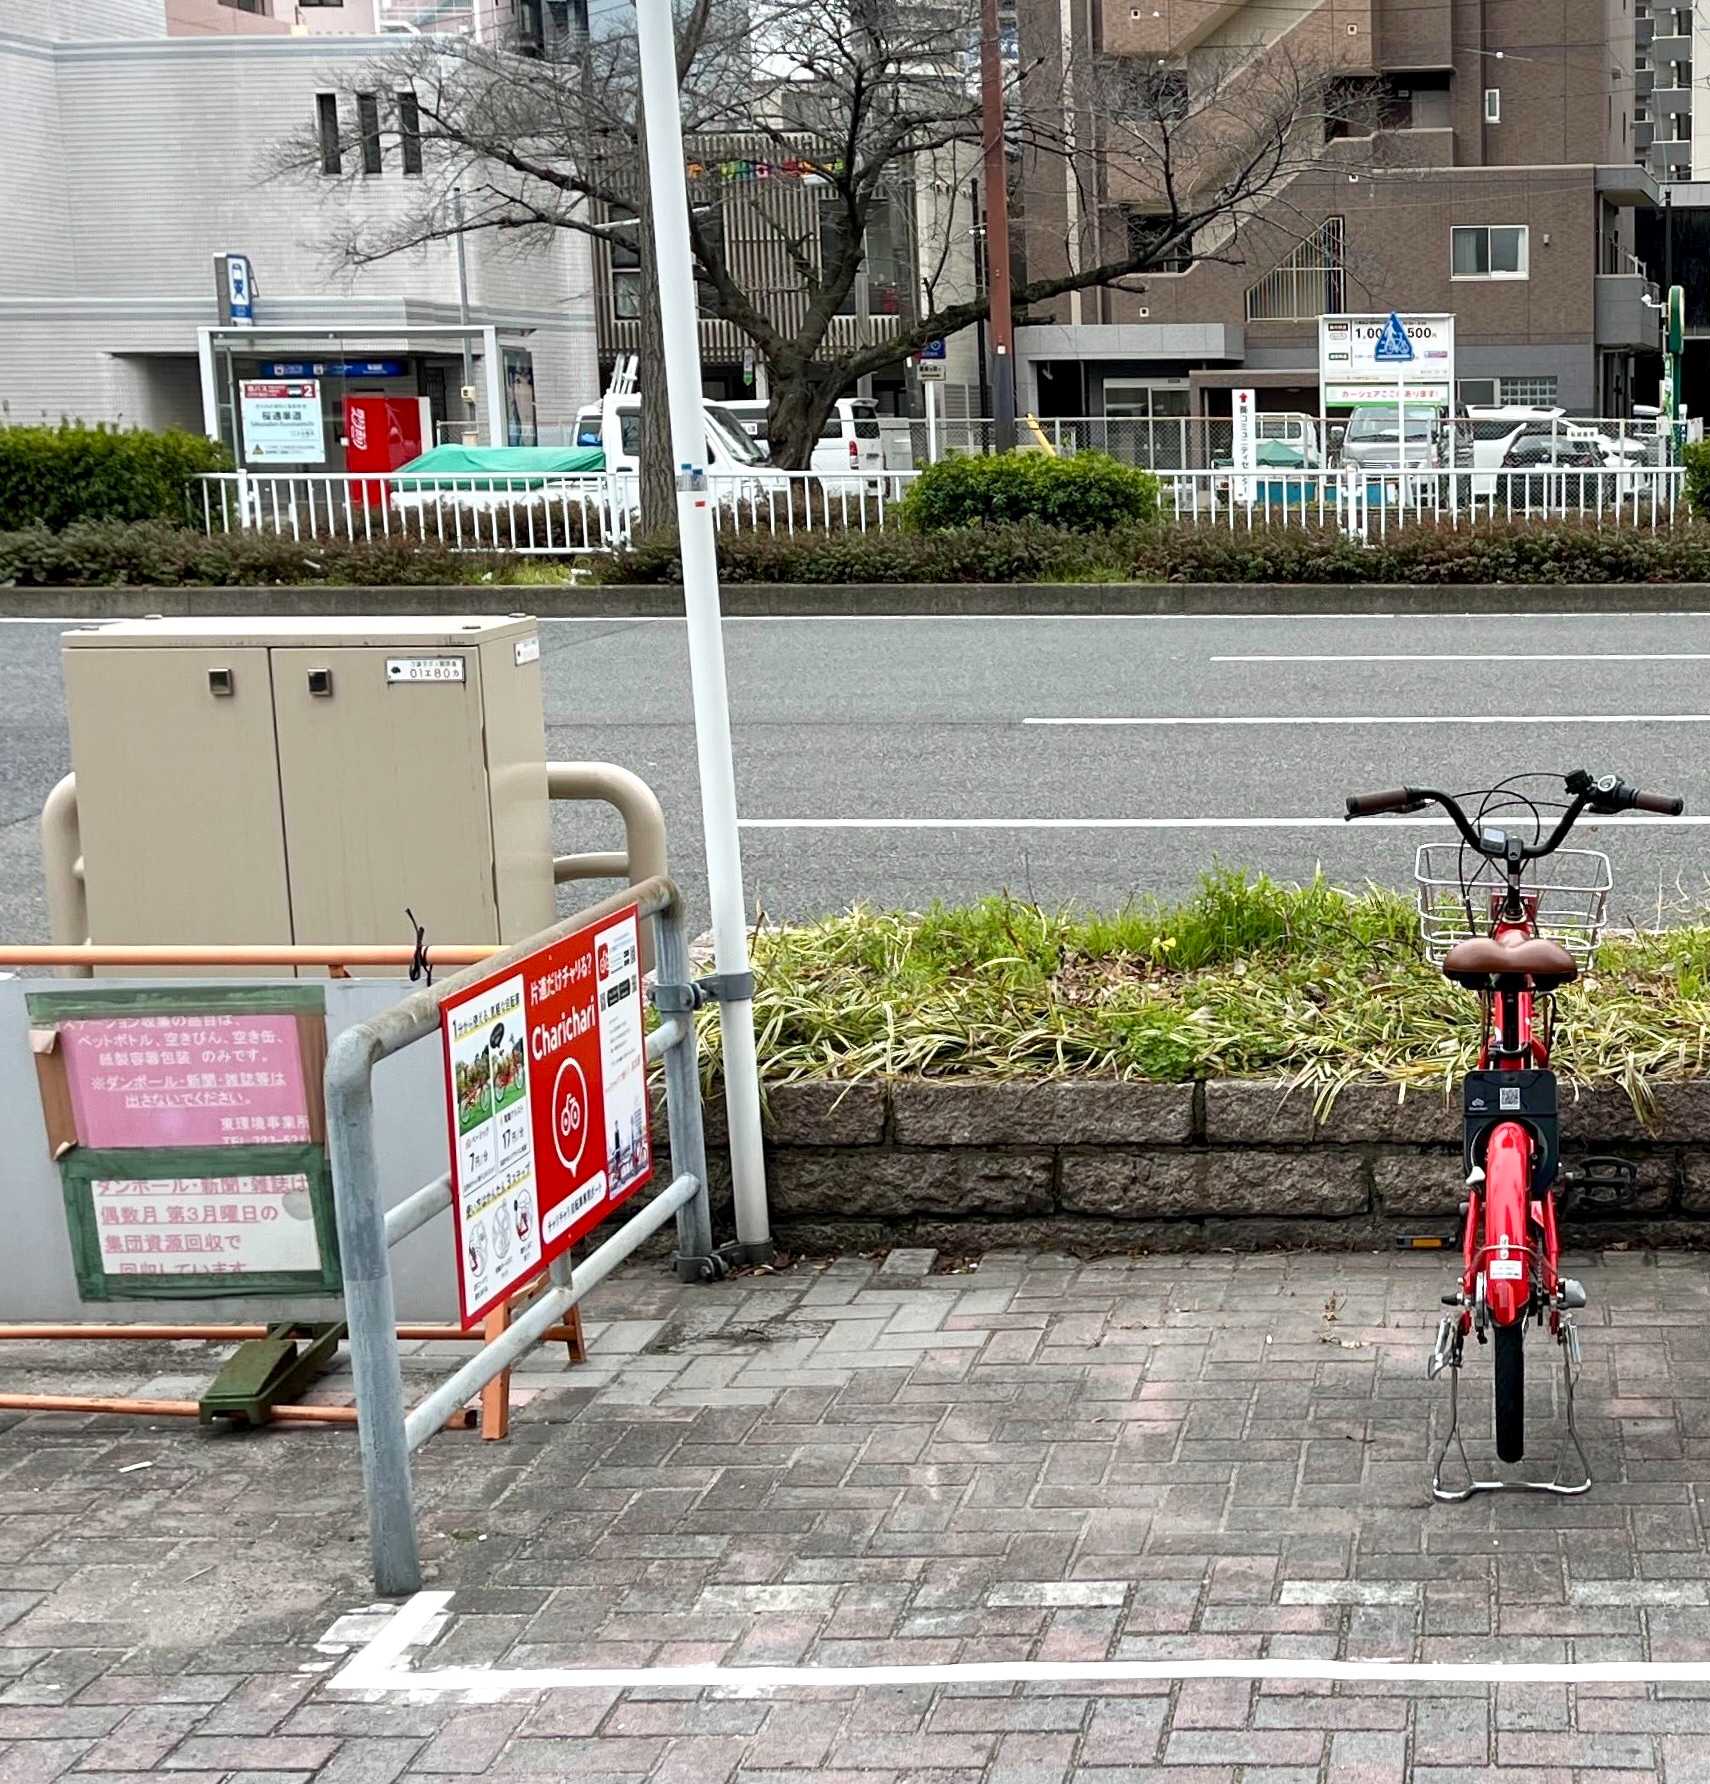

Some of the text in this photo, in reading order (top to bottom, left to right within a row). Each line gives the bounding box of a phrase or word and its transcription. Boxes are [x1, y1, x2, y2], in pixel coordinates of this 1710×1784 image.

[303, 385, 313, 397] 2
[531, 994, 596, 1061] Charichari
[101, 1206, 157, 1224] 偶数月
[105, 1234, 242, 1253] 集団資源回収で
